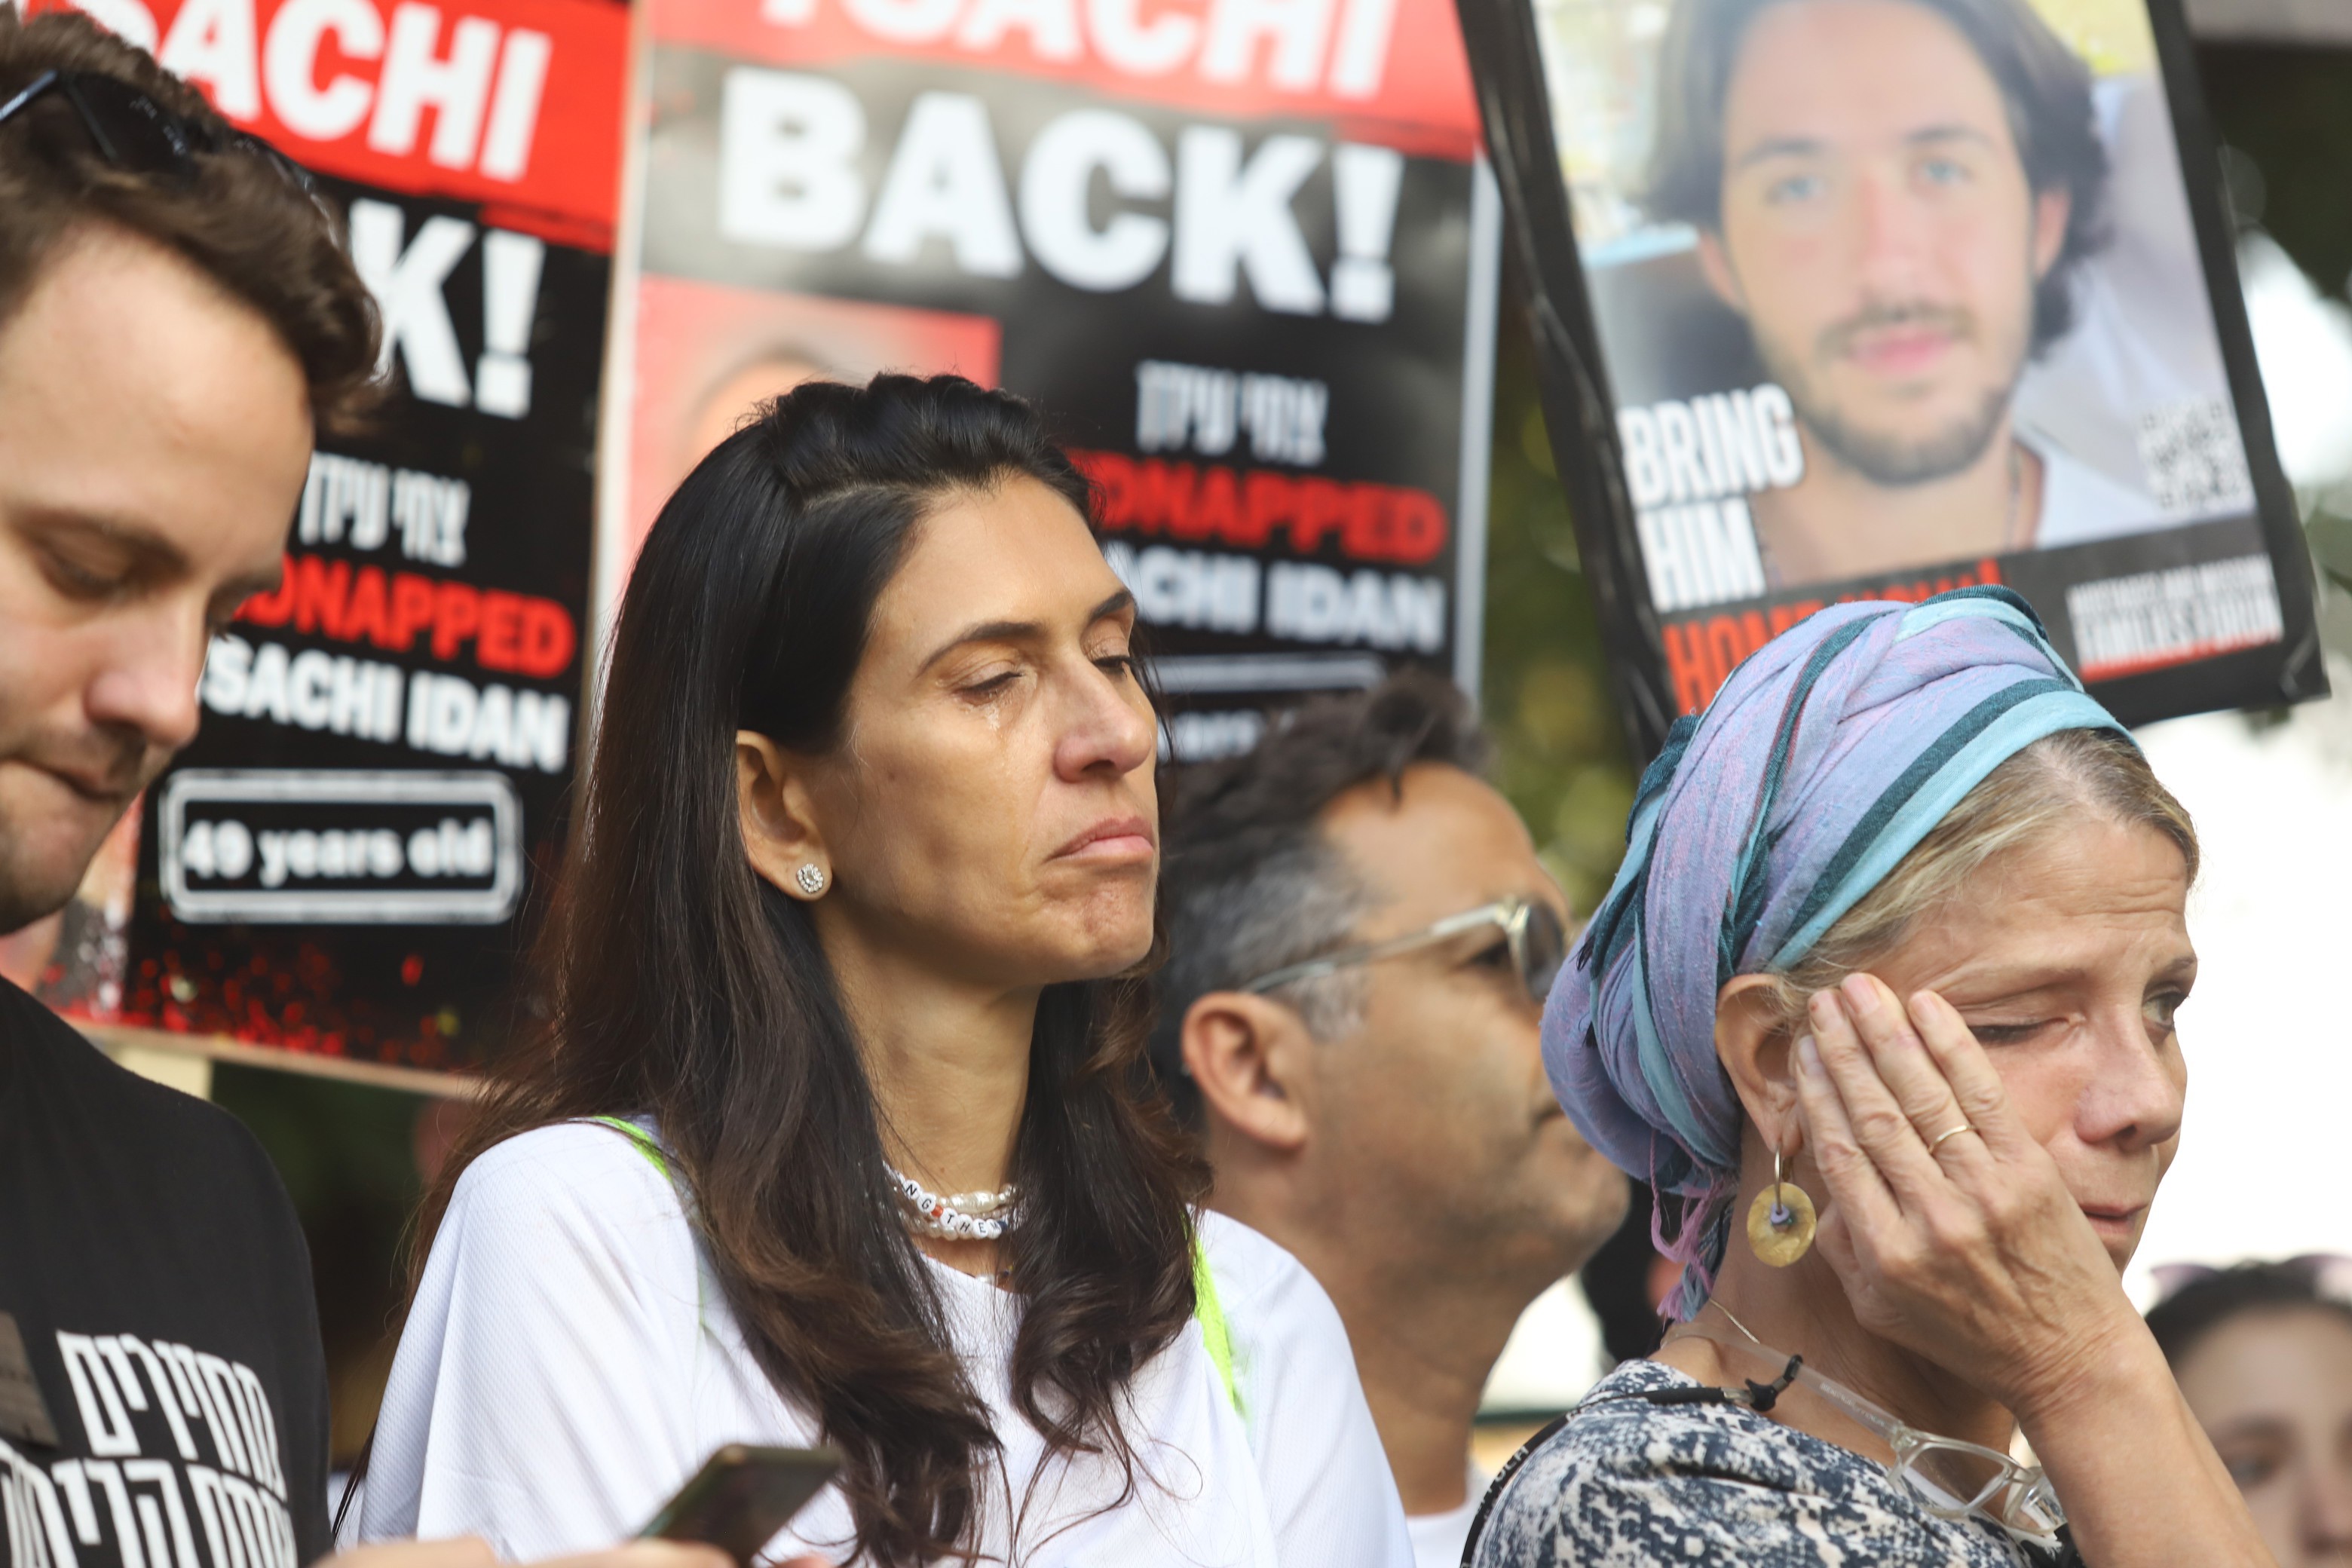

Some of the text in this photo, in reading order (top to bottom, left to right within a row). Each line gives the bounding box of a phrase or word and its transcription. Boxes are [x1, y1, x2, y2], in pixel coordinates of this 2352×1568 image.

[719, 66, 1404, 323] BACK!
[1063, 448, 1447, 565] DNAPPED
[1616, 381, 1804, 510] BRING
[230, 550, 576, 678] DNAPPED
[1264, 558, 1445, 653] IDAN
[1636, 494, 1768, 614] HIM
[194, 632, 571, 774] SACHI IDAN
[180, 816, 493, 888] 49 years old
